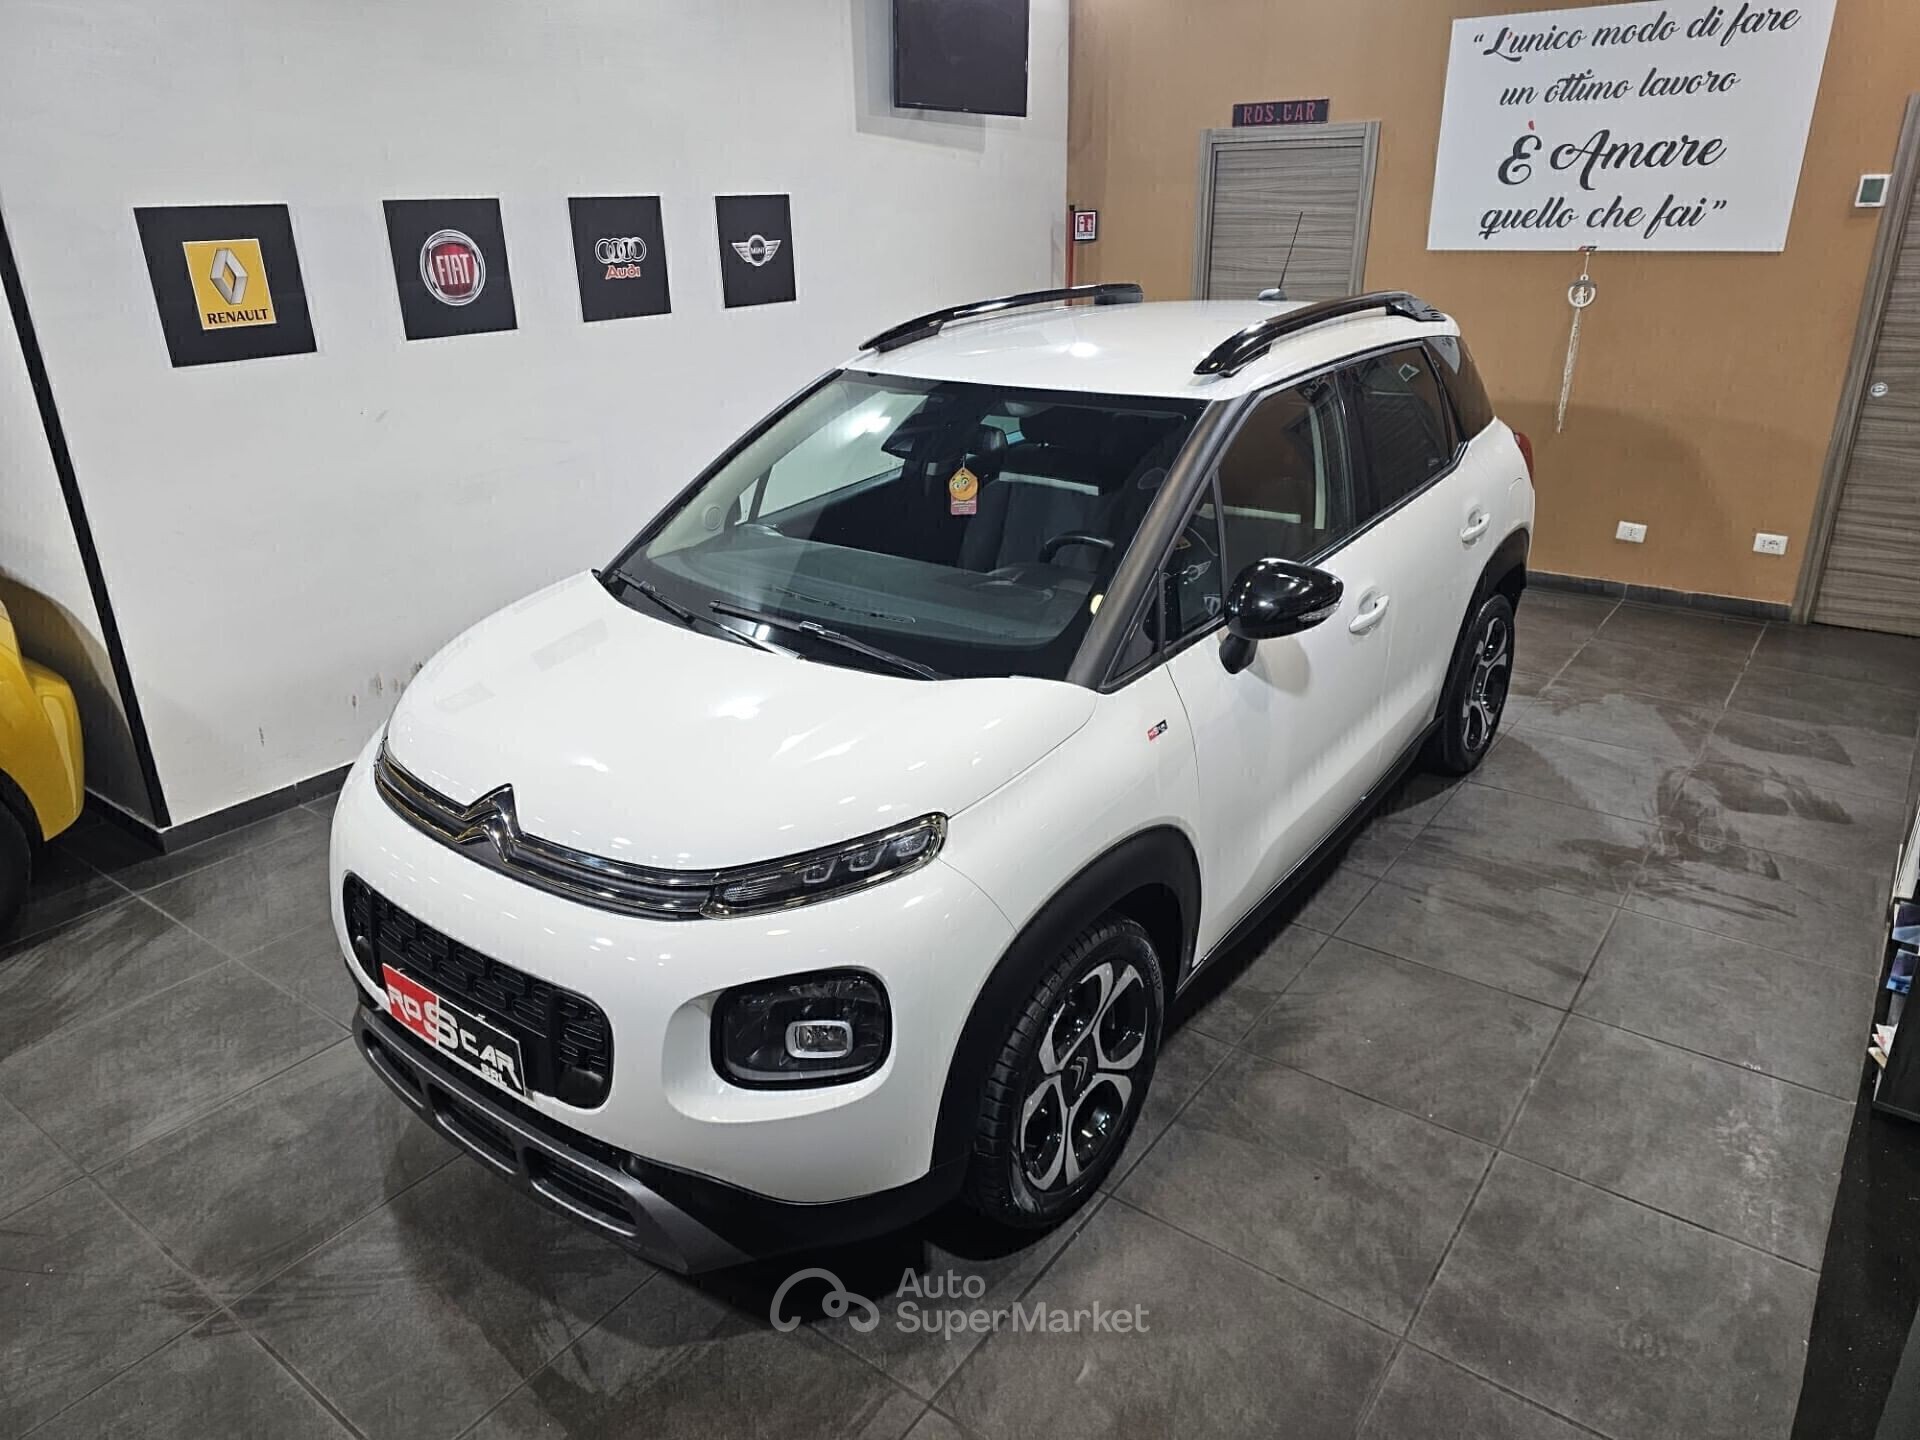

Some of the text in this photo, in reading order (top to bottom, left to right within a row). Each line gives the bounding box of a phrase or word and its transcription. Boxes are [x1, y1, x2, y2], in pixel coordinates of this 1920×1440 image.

[1591, 11, 1681, 47] modo
[1686, 6, 1725, 39] di
[1719, 2, 1802, 47] fare
[1499, 67, 1741, 106] un ottimo lavoro
[1549, 129, 1728, 191] Amare
[1478, 196, 1579, 240] quello
[1586, 195, 1647, 228] che
[750, 247, 768, 255] MINI
[435, 253, 471, 286] FIAT
[605, 263, 642, 281] Audi
[206, 308, 269, 325] RENAULT
